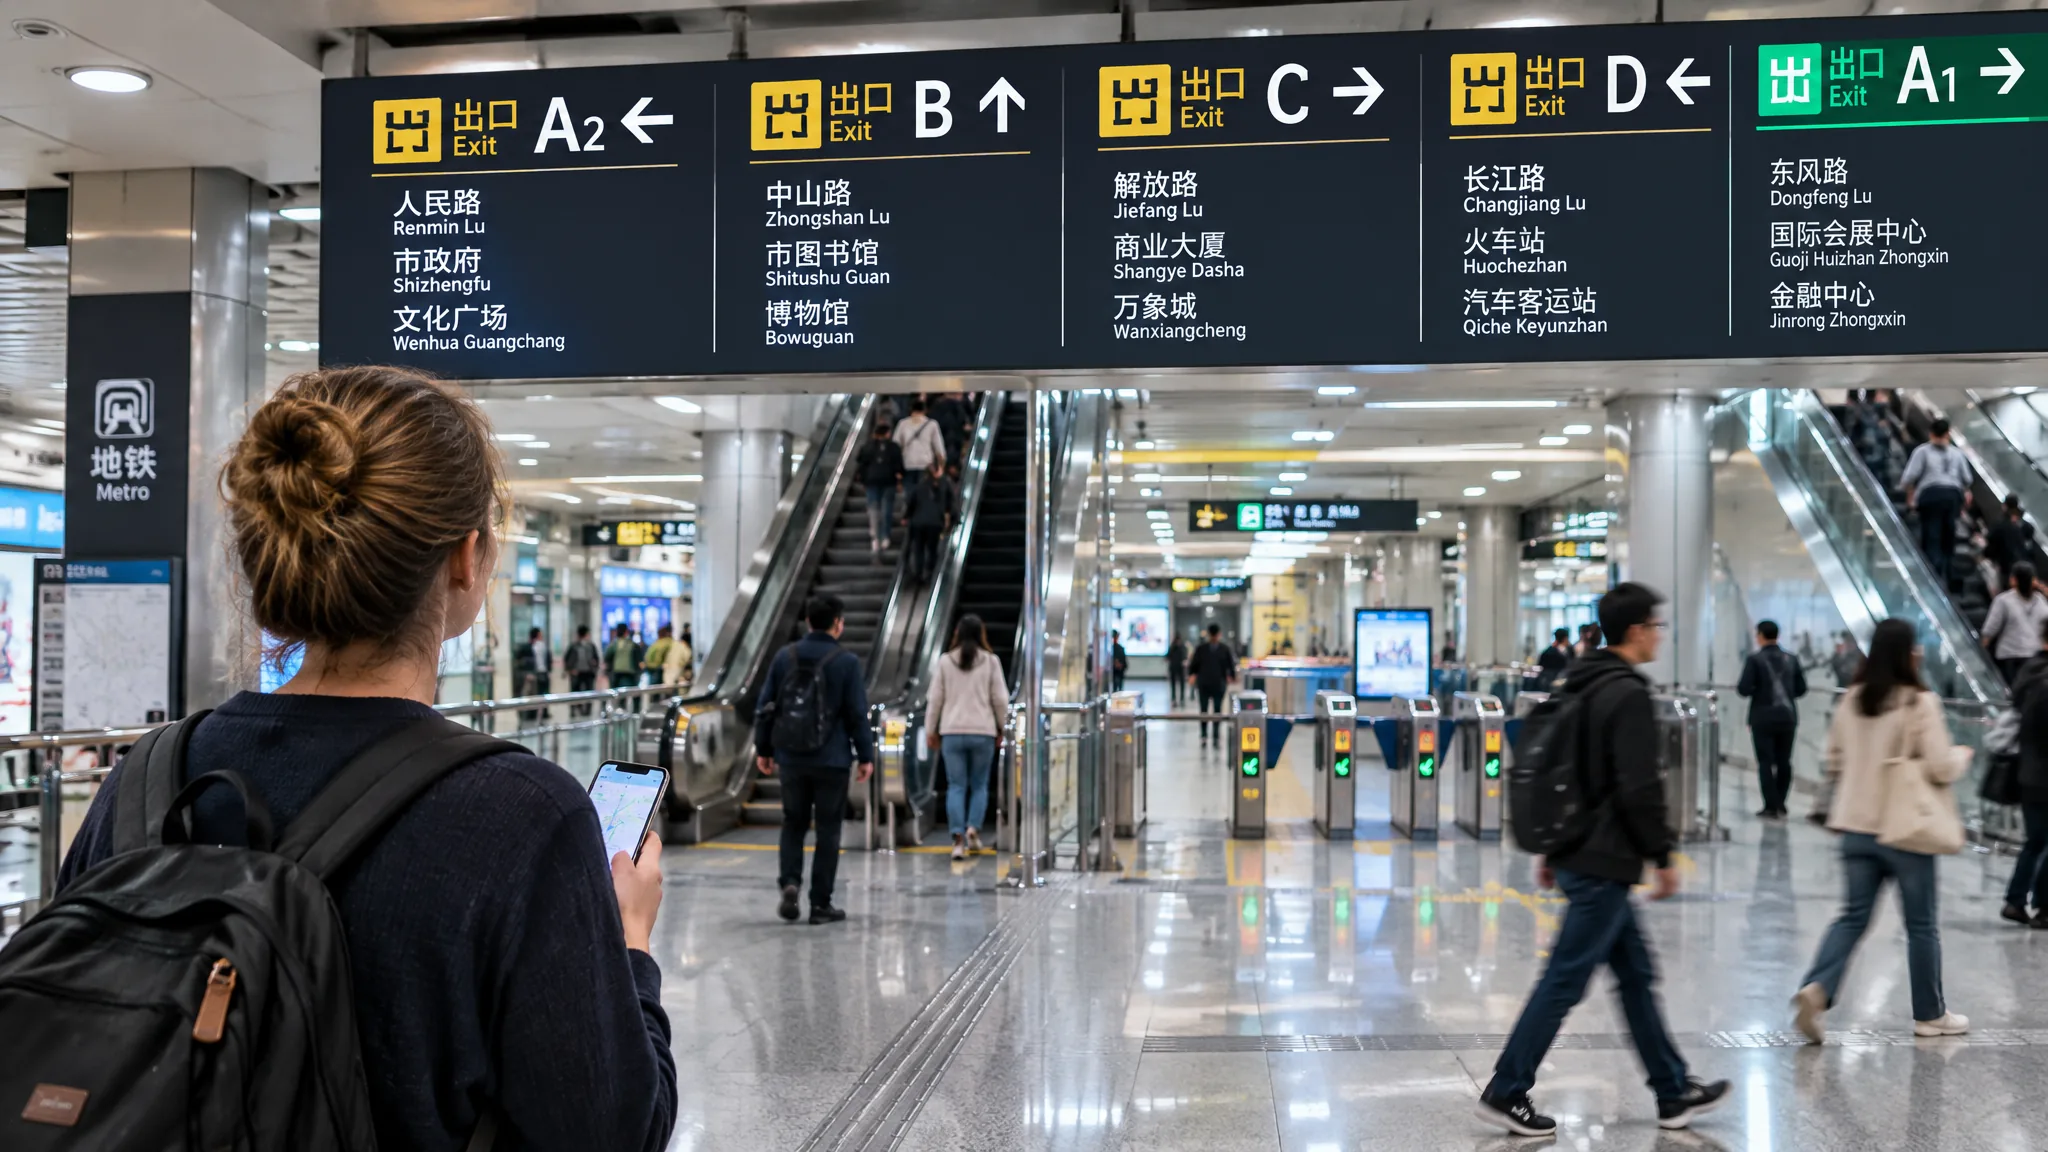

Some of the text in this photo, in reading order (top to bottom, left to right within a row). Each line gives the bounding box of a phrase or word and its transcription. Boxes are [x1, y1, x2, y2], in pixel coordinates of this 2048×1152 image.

[1526, 55, 1584, 90] 出口
[1830, 47, 1883, 80] 出口
[1897, 46, 1954, 103] A1
[1182, 67, 1244, 101] 出口
[1267, 63, 1308, 124] C
[1608, 55, 1646, 112] D
[1830, 85, 1867, 106] Exit
[831, 82, 891, 116] 出口
[916, 80, 952, 138] B
[1526, 95, 1565, 116] Exit
[454, 99, 516, 131] 出口
[534, 97, 604, 153] A2
[1182, 106, 1223, 128] Exit
[831, 120, 872, 141] Exit
[454, 135, 497, 156] Exit
[1114, 170, 1197, 199] 解放路
[1464, 164, 1545, 193] 长江路
[1771, 157, 1848, 185] 东风路
[394, 189, 481, 217] 人民路
[768, 179, 851, 208] 中山路
[1464, 195, 1585, 215] Changjiang Lu
[1771, 189, 1871, 209] Dongfeng Lu
[766, 209, 889, 229] Zhongshan Lu
[1114, 202, 1202, 221] Jiefang Lu
[394, 219, 484, 235] Renmin Lu
[1464, 226, 1545, 255] 火车站
[1771, 218, 1926, 248] 国际会展中心
[766, 239, 878, 267] 市图书馆
[1114, 232, 1225, 260] 商业大厦
[1771, 248, 1948, 271] Guoji Huizhan Zhongxin
[394, 246, 481, 275] 市政府
[1114, 261, 1243, 282] Shangye Dasha
[1464, 257, 1566, 273] Huochezhan
[394, 276, 490, 295] Shizhengfu
[766, 269, 889, 286] Shitushu Guan
[1114, 292, 1196, 320] 万象城
[1464, 287, 1596, 315] 汽车客运站
[1770, 281, 1874, 308] 金融中心
[394, 304, 507, 332] 文化广场
[766, 298, 848, 327] 博物馆
[1770, 311, 1905, 331] Jinrong Zhongxxin
[766, 330, 853, 348] Bowuguan
[1114, 322, 1245, 341] Wanxiangcheng
[1464, 317, 1607, 337] Qiche Keyunzhan
[393, 333, 564, 352] Wenhua Guangchang
[90, 445, 156, 479] 地铁
[97, 483, 149, 501] Metro
